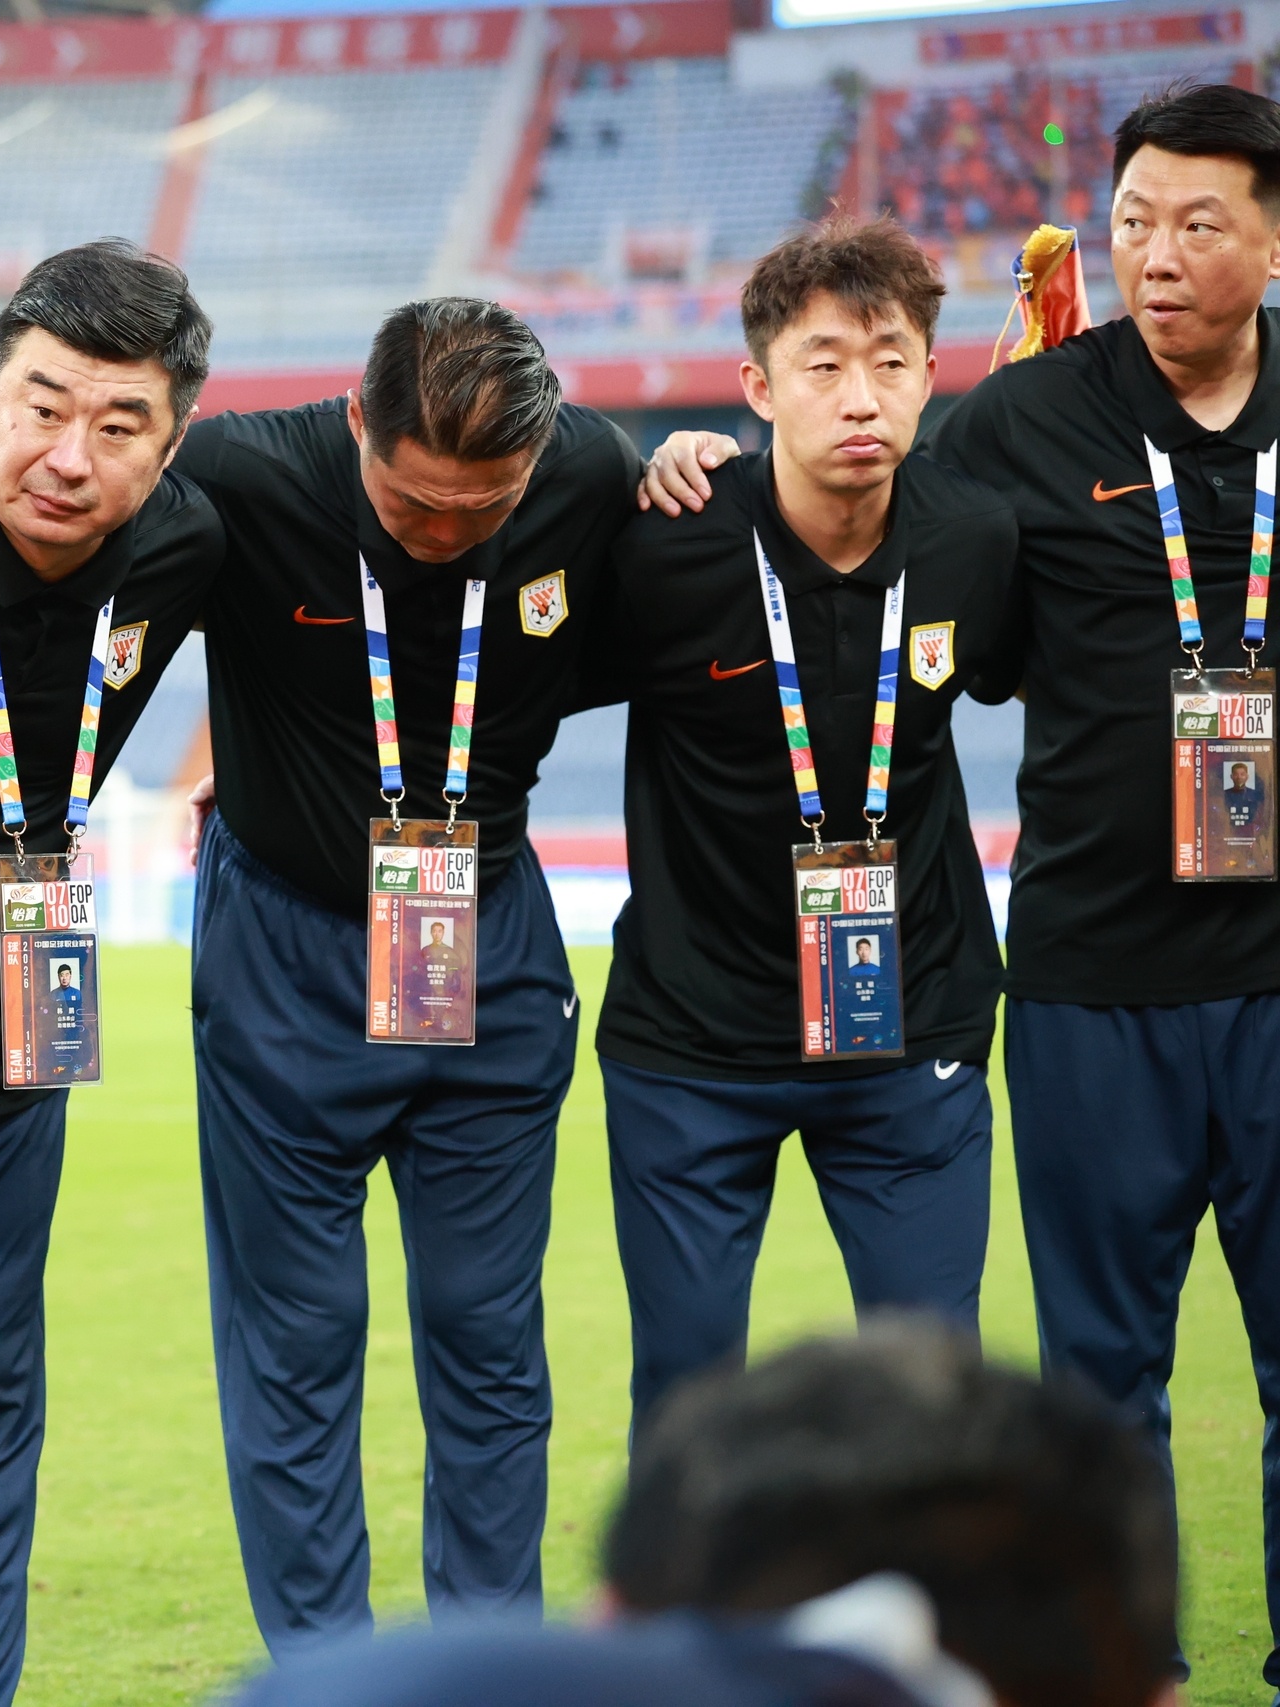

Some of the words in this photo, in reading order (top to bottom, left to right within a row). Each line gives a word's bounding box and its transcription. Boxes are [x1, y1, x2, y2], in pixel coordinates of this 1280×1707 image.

[114, 628, 140, 640] TSFC
[918, 629, 946, 640] TSFC
[1221, 695, 1243, 716] 07
[1246, 698, 1271, 715] FOP
[1224, 716, 1244, 736] 10
[422, 849, 444, 870] 07
[447, 852, 472, 871] FOP
[1180, 843, 1193, 872] TEAM
[424, 870, 444, 892] 10
[843, 868, 865, 890] 07
[868, 870, 892, 888] FOP
[46, 883, 66, 904] 07
[70, 884, 92, 904] FOP
[846, 890, 866, 911] 10
[50, 904, 68, 928] 10
[374, 1002, 387, 1031] TEAM
[808, 1021, 822, 1050] TEAM
[10, 1049, 22, 1080] TEAM
